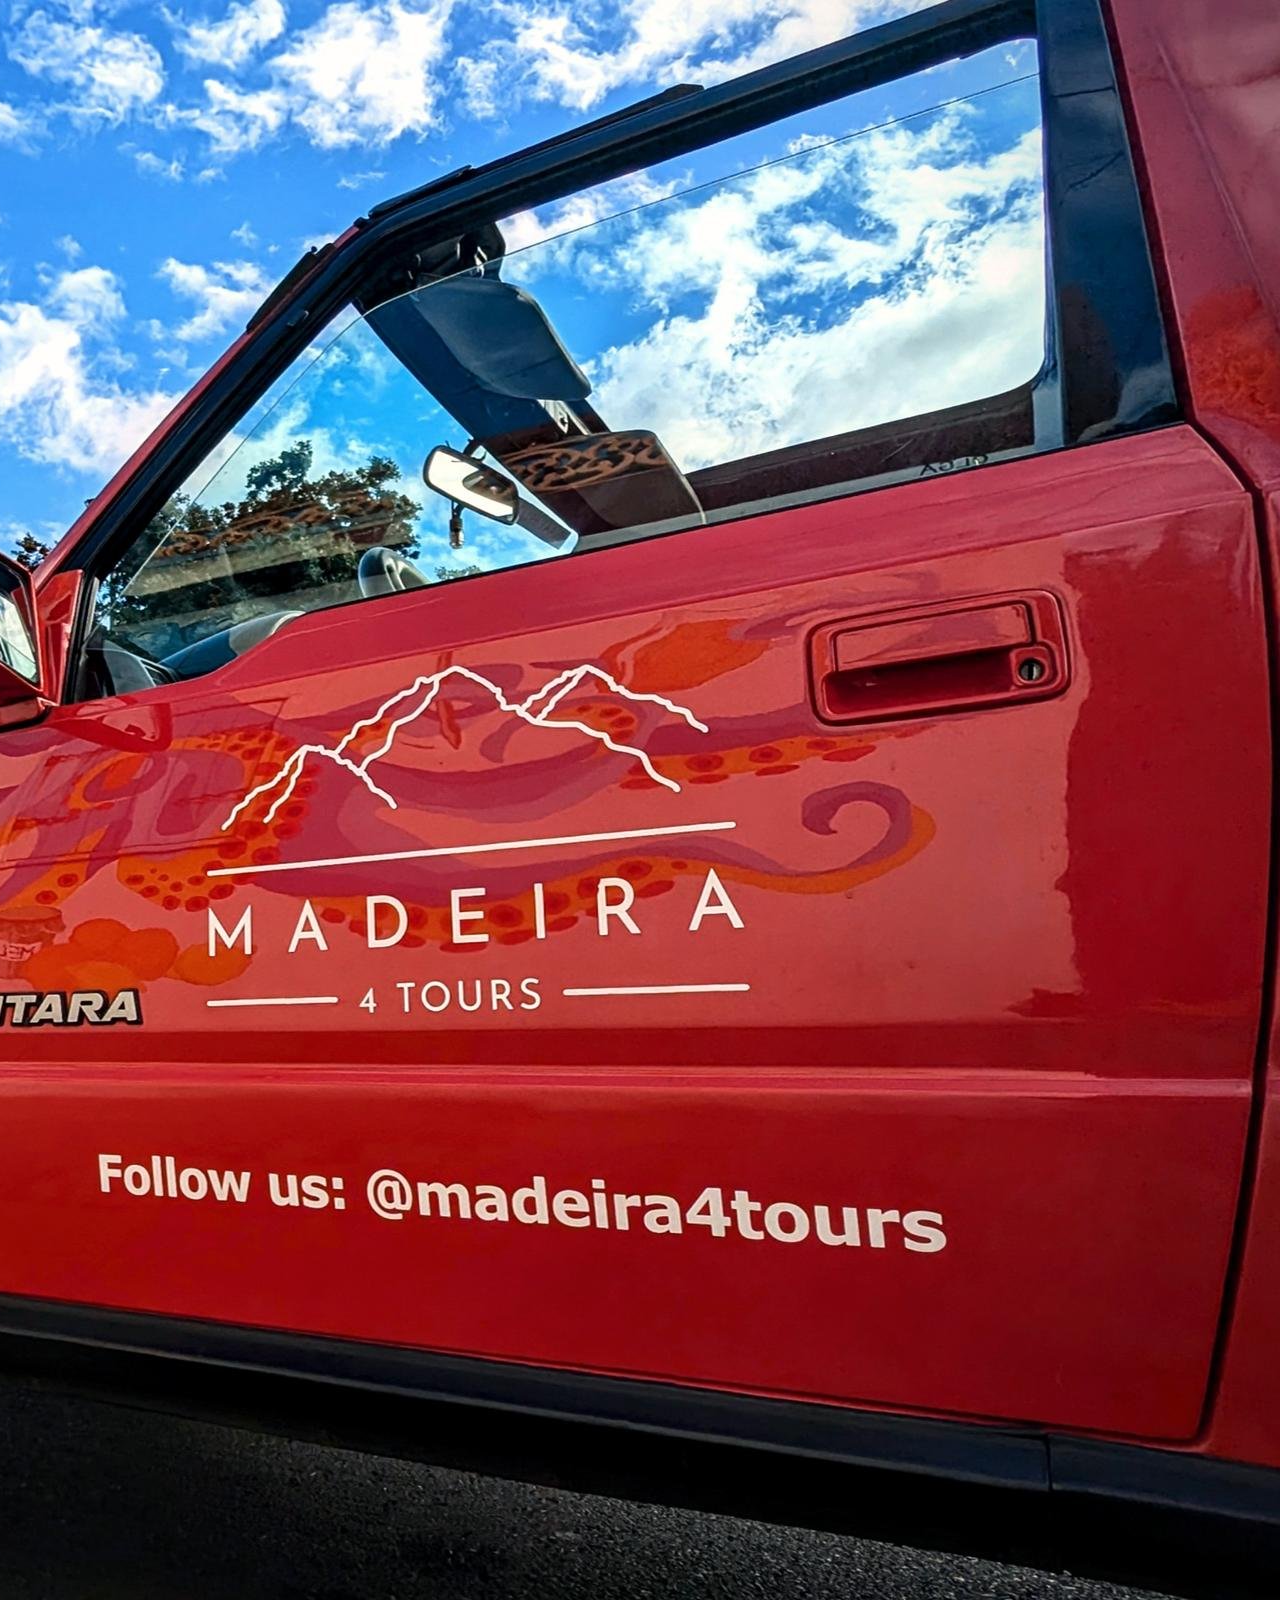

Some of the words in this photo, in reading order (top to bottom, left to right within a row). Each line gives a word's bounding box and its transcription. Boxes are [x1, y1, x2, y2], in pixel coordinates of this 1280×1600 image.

[207, 868, 745, 957] MADEIRA
[359, 987, 377, 1014] 4
[396, 977, 542, 1013] TOURS
[98, 1154, 252, 1203] Follow
[268, 1173, 346, 1210] us:
[367, 1169, 948, 1253] @madeira4tours
